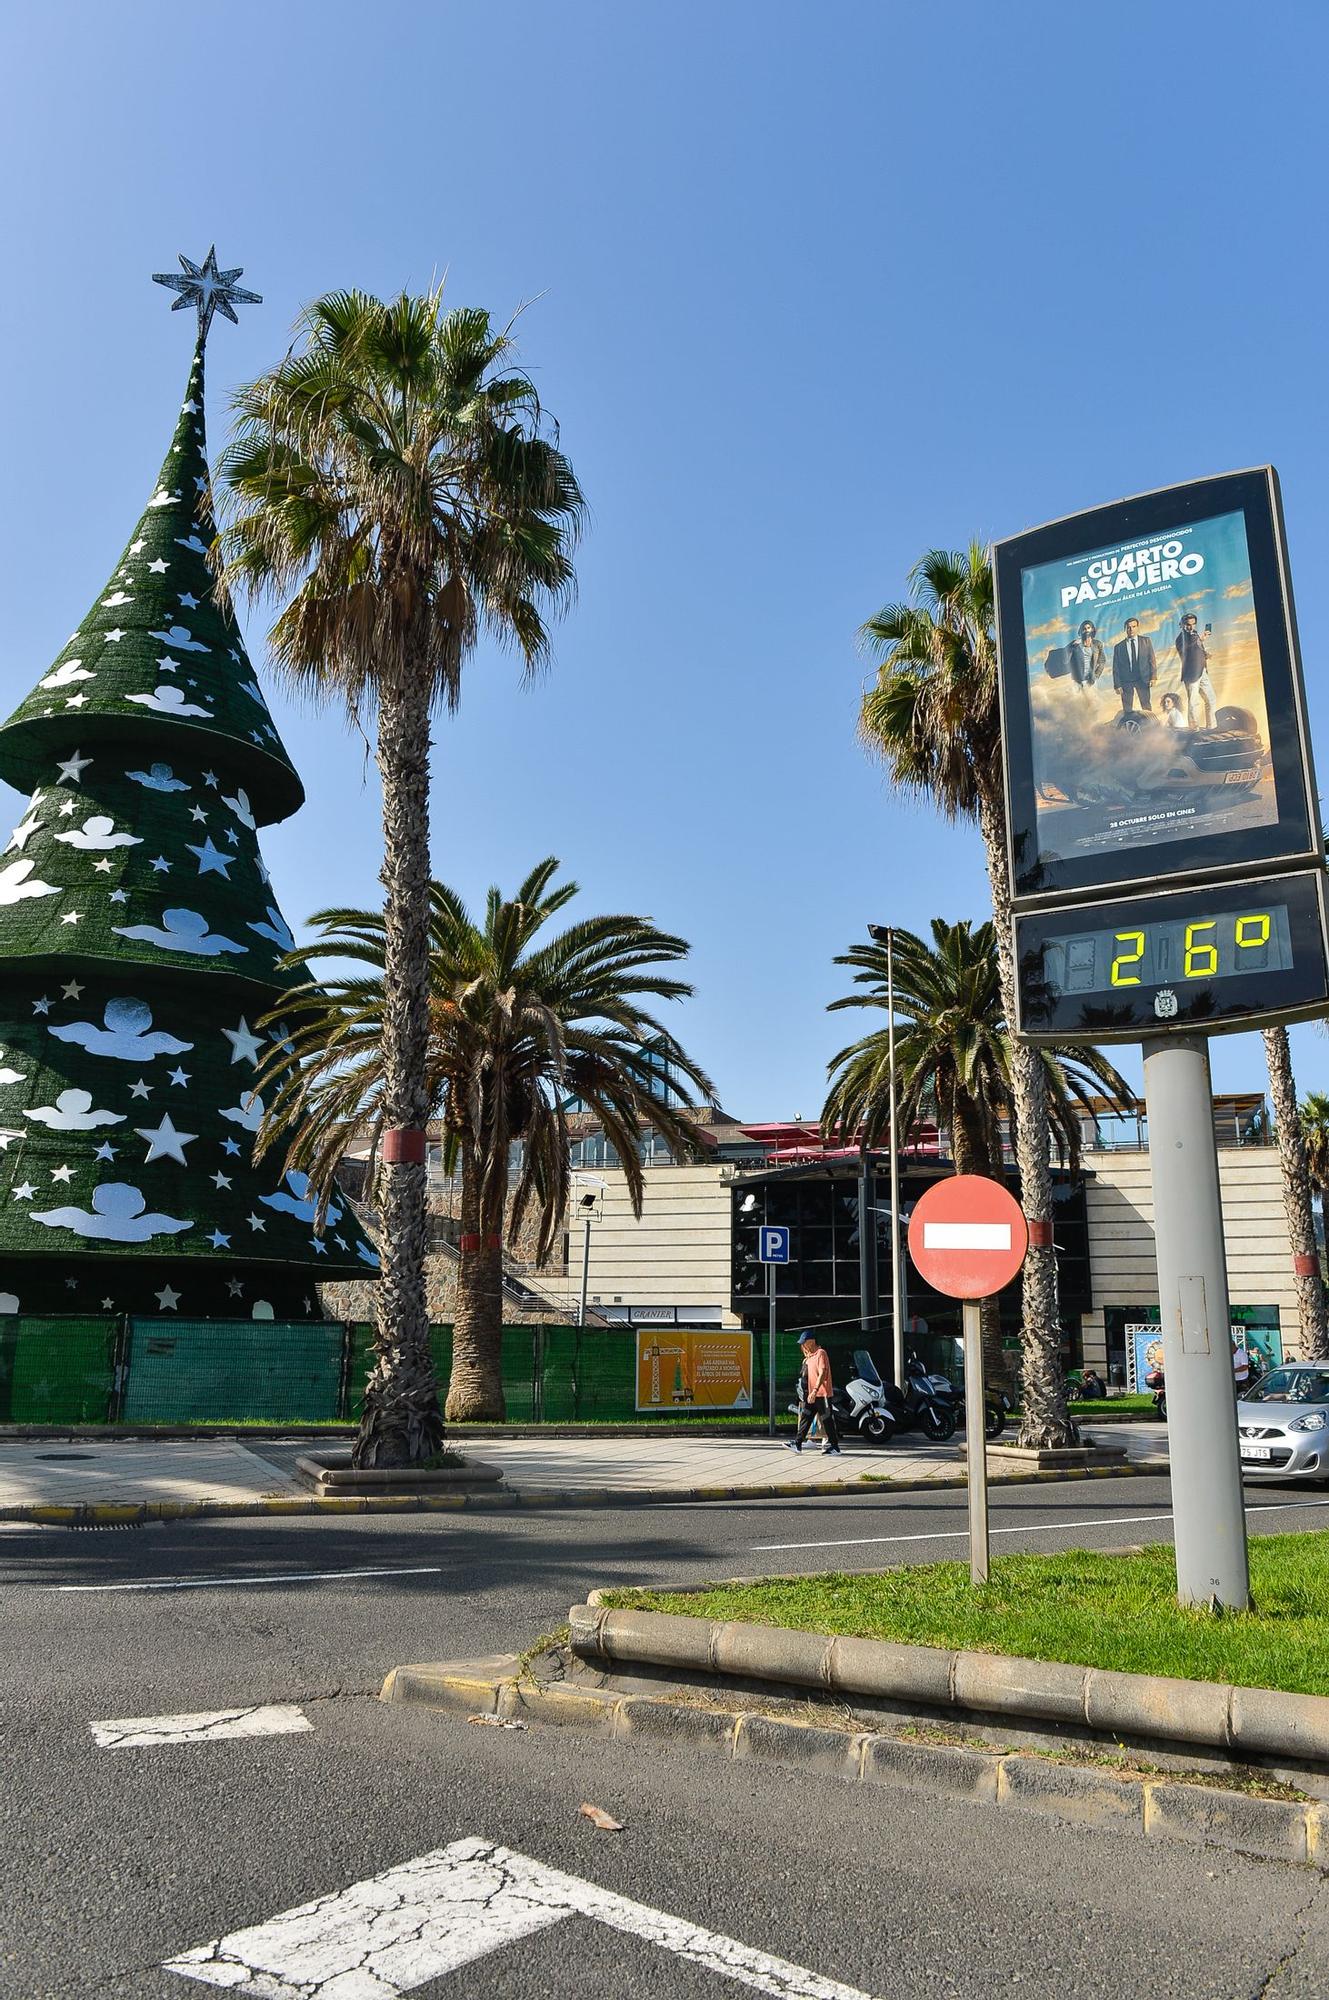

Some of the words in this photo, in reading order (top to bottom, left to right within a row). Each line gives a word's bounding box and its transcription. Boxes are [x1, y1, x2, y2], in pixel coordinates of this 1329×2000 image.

[1120, 540, 1148, 550] PERFECTOS
[1150, 528, 1192, 544] DESCONOCIDOS
[1087, 540, 1183, 579] CU4RTO
[1060, 553, 1204, 608] PASAJERO
[1119, 816, 1147, 826] OCTUBRE
[1148, 813, 1165, 821] SOLO
[1177, 808, 1196, 816] CINES
[766, 1232, 782, 1258] P
[634, 1310, 672, 1319] GRANIER
